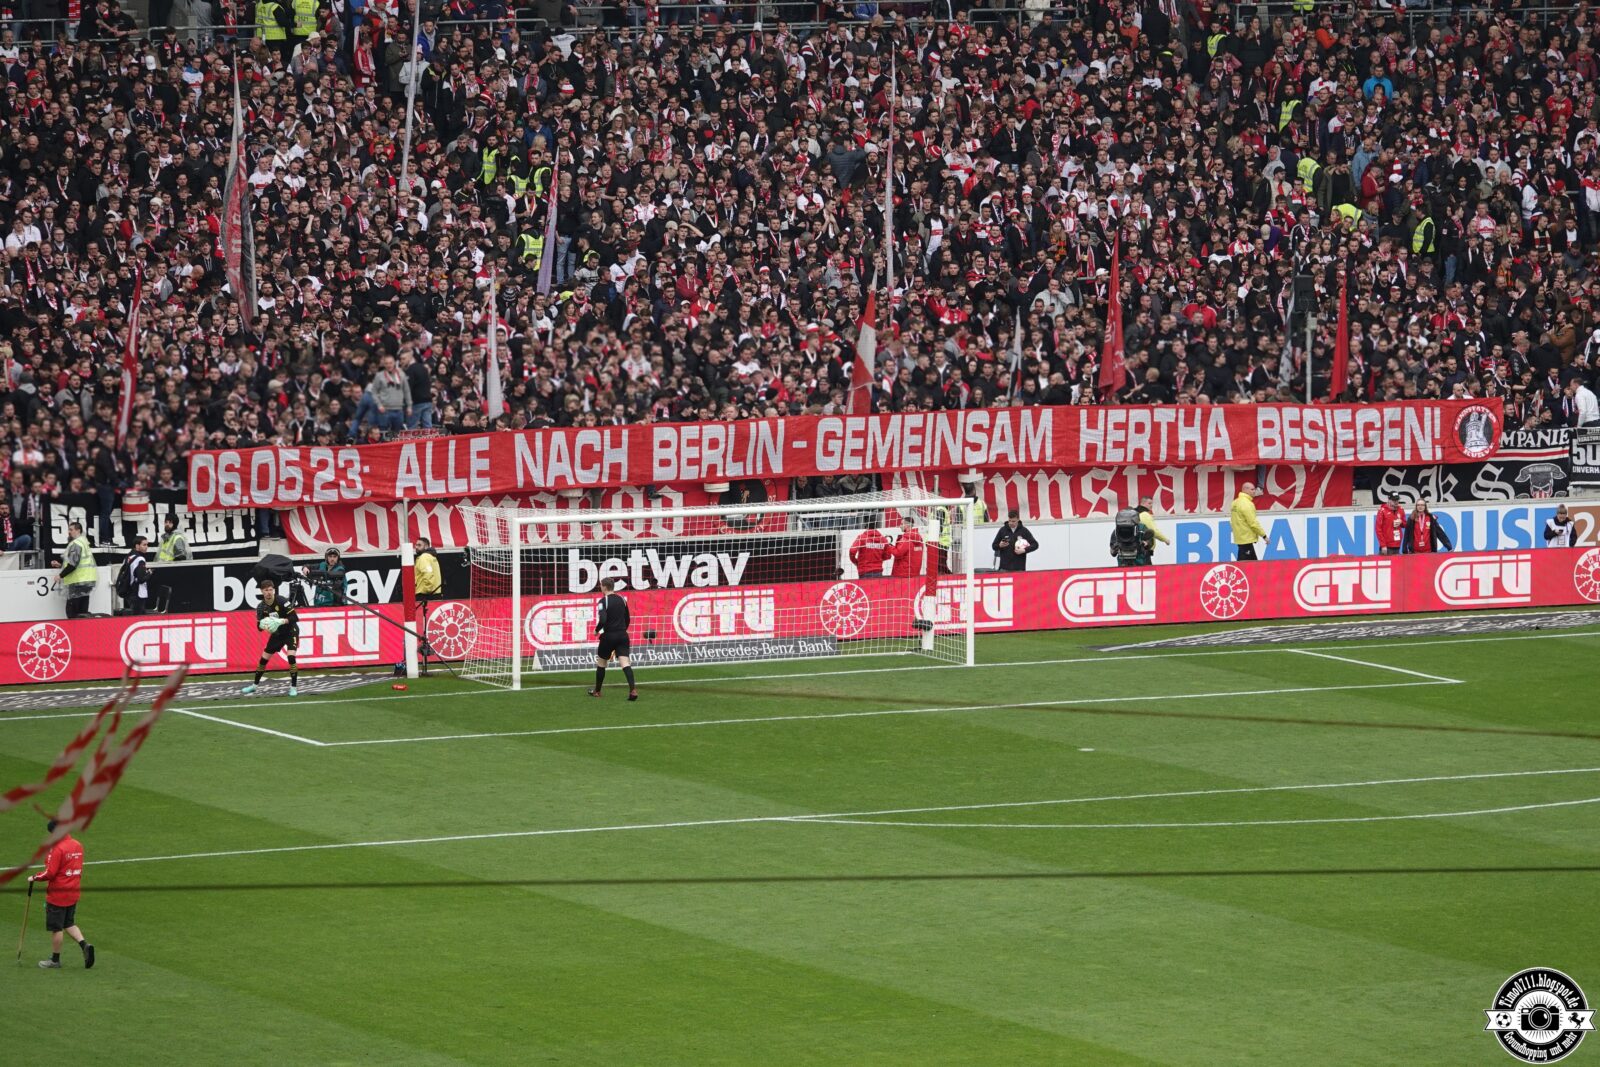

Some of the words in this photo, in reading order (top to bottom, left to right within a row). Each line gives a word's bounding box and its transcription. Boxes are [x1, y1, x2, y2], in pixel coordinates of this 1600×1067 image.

[191, 448, 372, 508] 06.05.23:
[395, 437, 491, 498] ALLE
[514, 428, 629, 488] NACH
[652, 419, 785, 481] BERLIN
[792, 440, 808, 449] -
[816, 408, 1053, 472] GEMEINSAM
[1079, 406, 1233, 463] HERTHA
[1256, 405, 1442, 462] BESIEGEN!
[568, 549, 750, 594] betway
[1064, 570, 1156, 615] GTÜ
[1299, 560, 1391, 602] GTÜ
[1441, 554, 1531, 596] GTÜ
[681, 589, 775, 633] GTÜ
[127, 617, 227, 662] GTÜ
[649, 647, 684, 663] Bank
[694, 641, 795, 660] Mercedes-Benz
[799, 638, 834, 653] Bank
